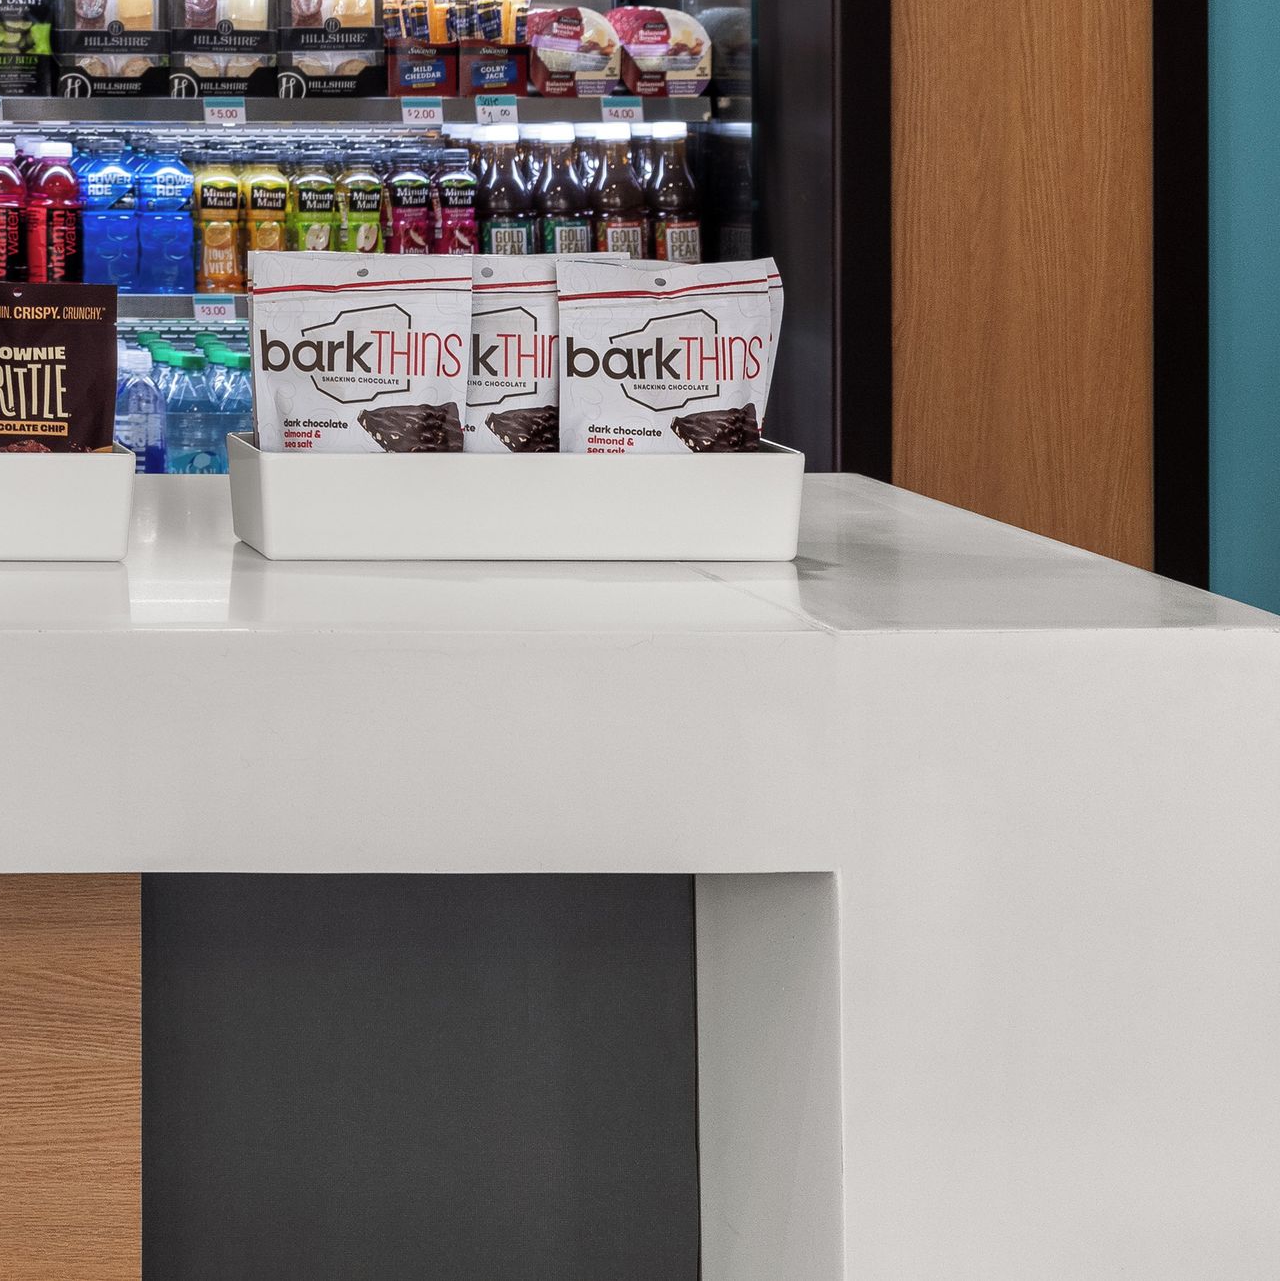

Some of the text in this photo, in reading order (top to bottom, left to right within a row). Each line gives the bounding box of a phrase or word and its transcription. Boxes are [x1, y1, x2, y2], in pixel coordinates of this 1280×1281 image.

[84, 37, 149, 47] HILLSHIRE
[193, 35, 258, 47] HILLSHIRE
[301, 33, 366, 44] HILLSHIRE
[413, 65, 433, 73] MILD
[405, 72, 441, 80] CHEDDAR
[485, 72, 504, 80] JACK
[210, 108, 238, 119] $5.00
[407, 108, 435, 119] $2.00
[608, 108, 634, 119] $4.00
[88, 174, 131, 185] POWER
[88, 184, 112, 195] ADE
[203, 187, 237, 198] Minute
[352, 191, 380, 201] Minute
[207, 197, 234, 207] Maid
[357, 200, 377, 209] Maid
[8, 210, 19, 256] water
[496, 230, 524, 244] GOLD
[670, 230, 698, 244] GOLD
[671, 244, 698, 257] PEAK
[13, 306, 61, 320] CRISPY.
[201, 306, 226, 316] $3.00
[358, 377, 400, 385] CHOCOLATE
[485, 379, 527, 388] CHOCOLATE
[668, 383, 709, 391] CHOCOLATE
[40, 423, 66, 433] CHIP
[284, 418, 348, 429] dark chocolate
[284, 429, 321, 438] almond &
[588, 424, 662, 437] dark chocolate
[297, 440, 313, 448] salt
[588, 435, 634, 446] almond &
